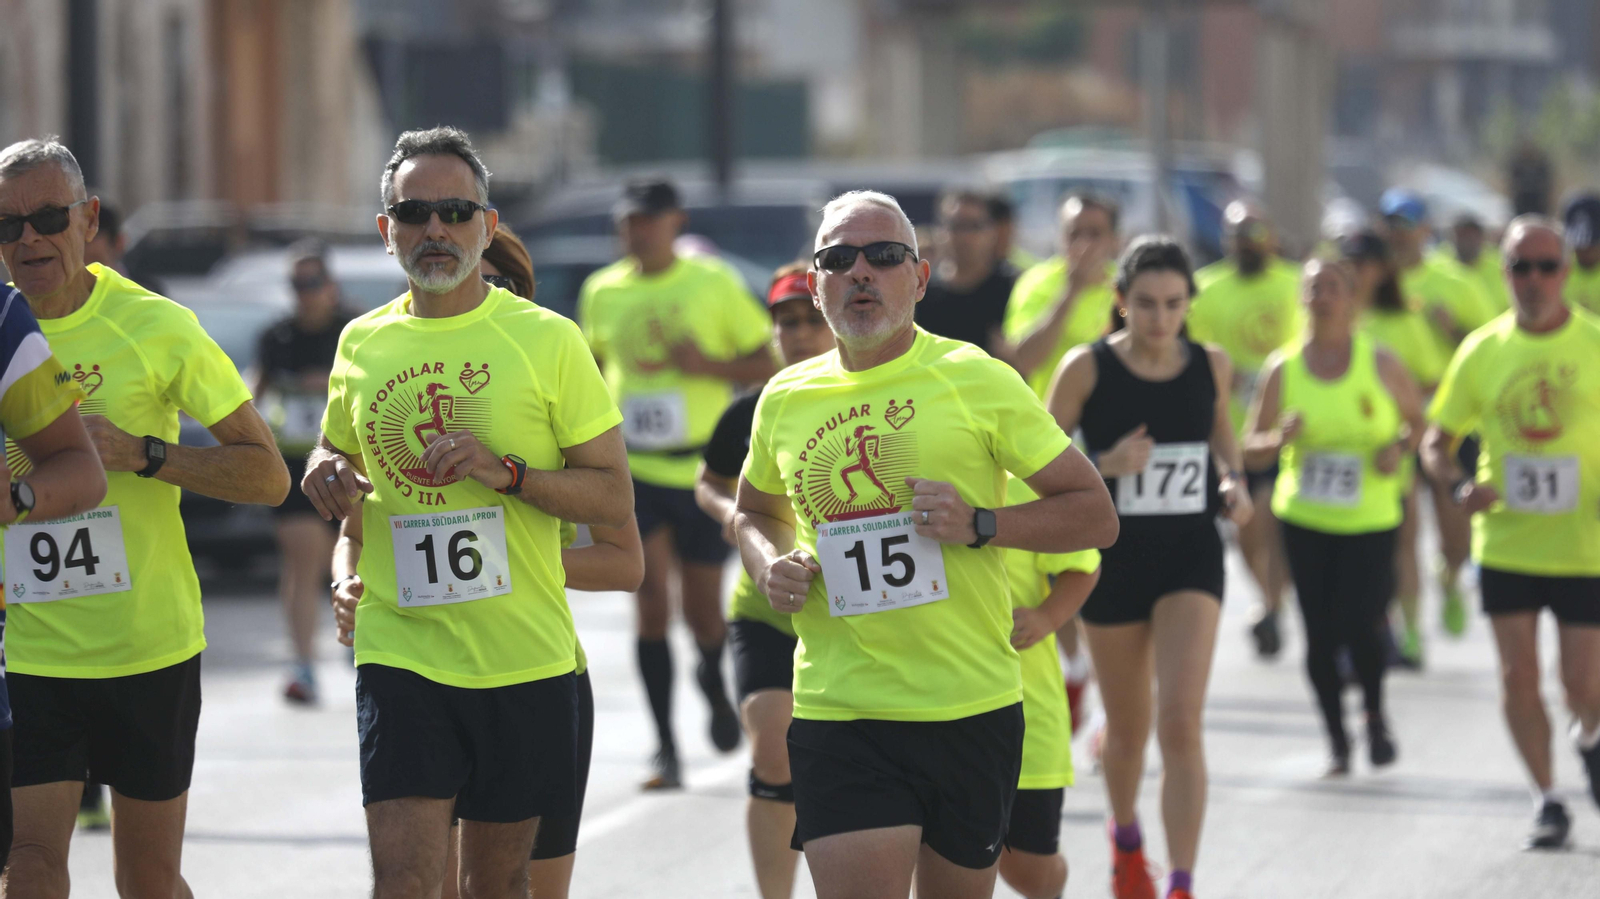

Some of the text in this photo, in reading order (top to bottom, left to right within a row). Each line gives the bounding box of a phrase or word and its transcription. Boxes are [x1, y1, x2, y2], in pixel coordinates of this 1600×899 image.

[366, 361, 447, 506] VII CARRERA POPULAR
[799, 404, 871, 462] POPULAR
[406, 471, 431, 486] PUENTE
[794, 468, 821, 530] RRERA
[1517, 467, 1558, 501] 31
[87, 510, 113, 520] APRON
[403, 519, 431, 529] CARRERA
[432, 514, 470, 527] SOLIDARIA
[472, 511, 497, 521] APRON
[829, 524, 861, 537] CARRERA
[862, 518, 901, 532] SOLIDARIA
[903, 517, 916, 527] AP
[29, 527, 100, 582] 94
[415, 530, 483, 584] 16
[844, 534, 916, 592] 15
